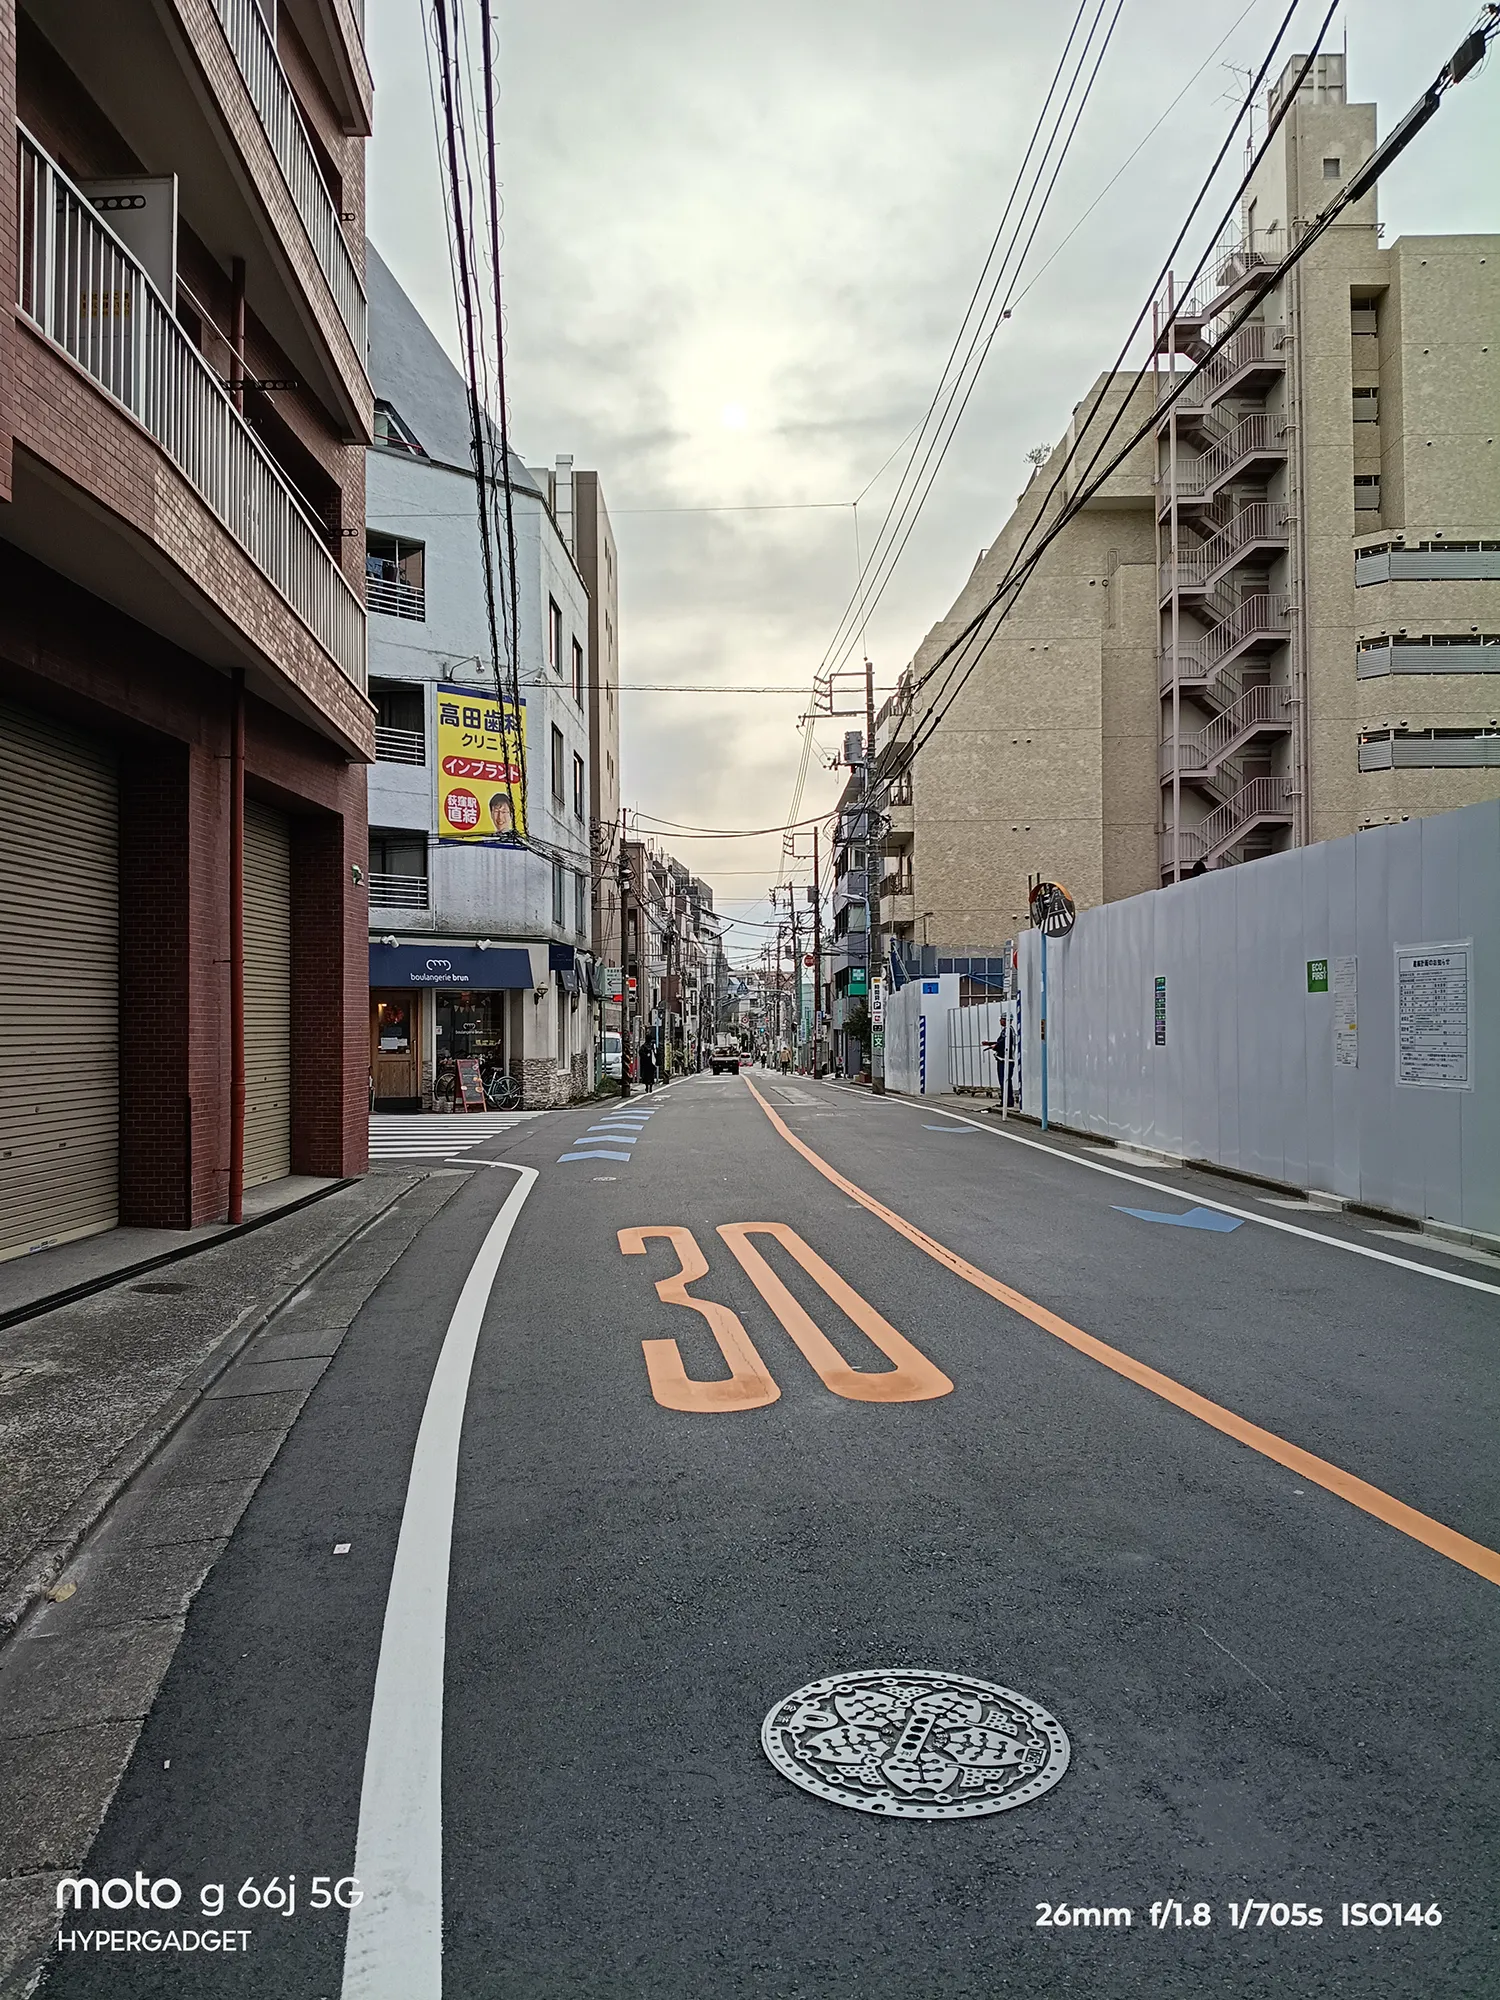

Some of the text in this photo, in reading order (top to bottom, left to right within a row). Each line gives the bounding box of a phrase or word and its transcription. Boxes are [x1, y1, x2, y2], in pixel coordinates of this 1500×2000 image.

[445, 758, 519, 781] インプラント
[447, 807, 477, 824] 直結
[1312, 963, 1323, 971] ECO
[410, 973, 451, 982] boulangerie
[617, 1222, 954, 1413] 30
